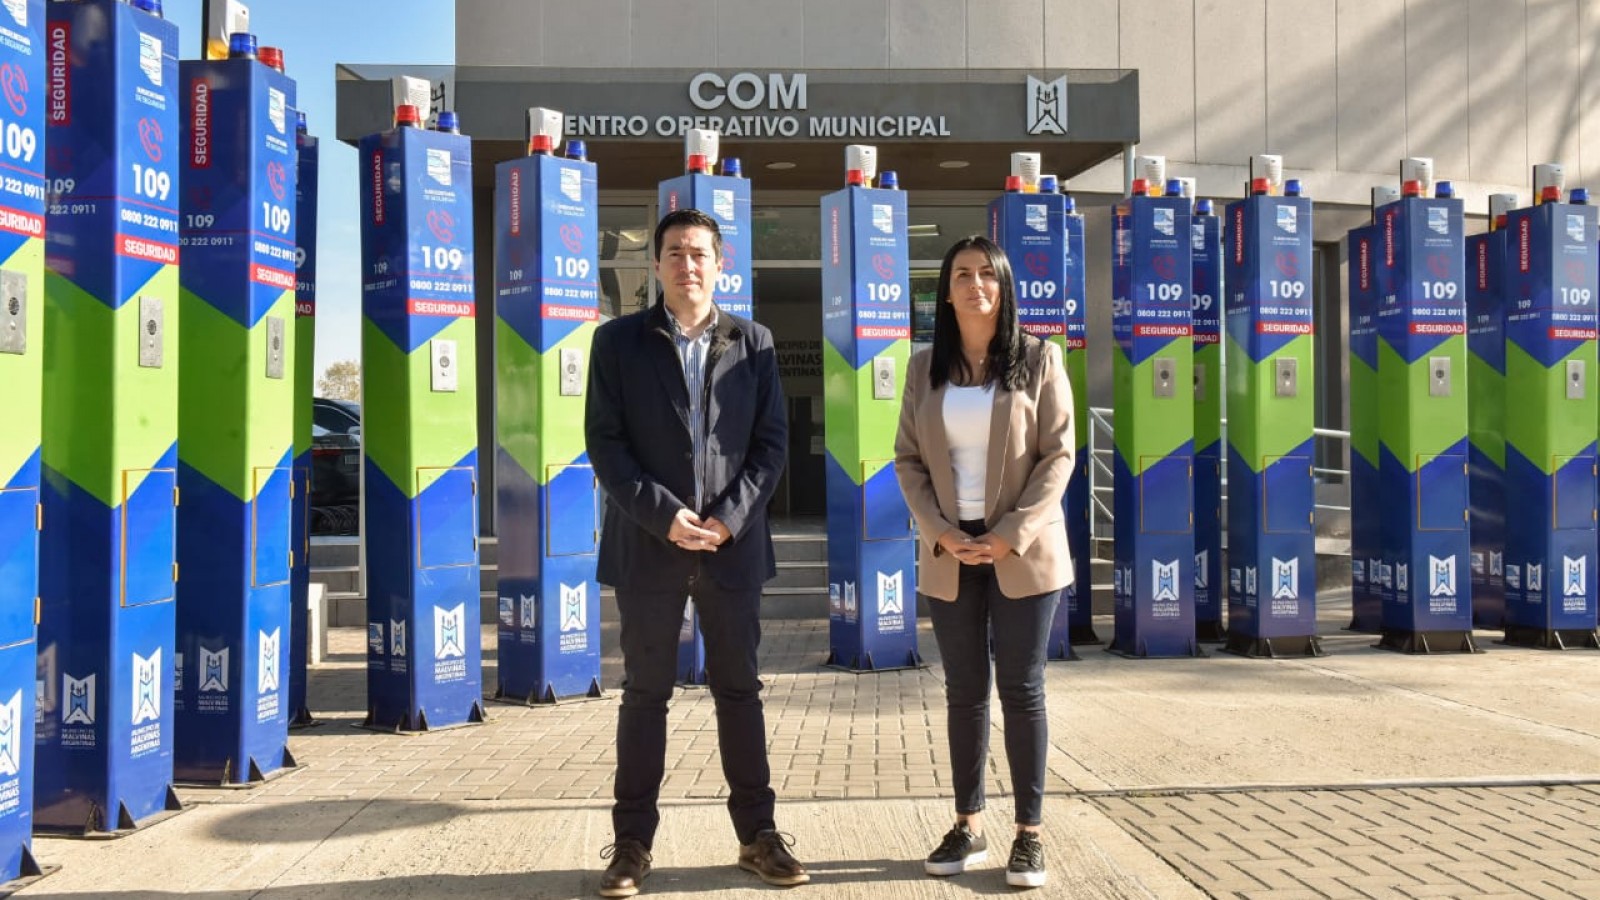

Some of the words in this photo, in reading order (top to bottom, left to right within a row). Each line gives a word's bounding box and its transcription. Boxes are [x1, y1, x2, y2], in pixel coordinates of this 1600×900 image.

[53, 28, 66, 120] SEGURIDAD
[689, 72, 808, 110] COM
[195, 83, 207, 164] SEGURIDAD
[564, 115, 649, 136] ENTRO
[655, 115, 799, 137] OPERATIVO
[809, 115, 951, 137] MUNICIPAL
[5, 177, 22, 194] 222
[24, 183, 45, 200] 0911
[132, 164, 170, 201] 109
[71, 204, 96, 214] 0911
[511, 172, 519, 233] SEGURIDAD
[0, 213, 41, 234] GURIDAD
[121, 209, 142, 226] 0800
[143, 214, 159, 229] 222
[159, 218, 178, 234] 0911
[187, 214, 215, 228] 109
[262, 201, 290, 234] 109
[124, 239, 176, 261] SEGURIDAD
[191, 238, 208, 246] 222
[210, 237, 233, 246] 0911
[421, 246, 462, 270] 109
[554, 256, 590, 279] 109
[256, 268, 293, 287] SEGURIDAD
[410, 280, 432, 291] 0800
[434, 283, 450, 292] 222
[452, 283, 473, 294] 0911
[544, 286, 563, 297] 0800
[564, 287, 579, 298] 222
[580, 288, 597, 300] 0911
[867, 283, 901, 302] 109
[1019, 280, 1056, 299] 109
[1146, 283, 1182, 301] 109
[1269, 280, 1305, 298] 109
[1422, 281, 1457, 299] 109
[1192, 294, 1212, 310] 09
[1560, 287, 1591, 305] 109
[414, 302, 470, 315] SEGURIDAD
[548, 307, 596, 319] SEGURIDAD
[858, 310, 876, 319] 0800
[878, 311, 891, 320] 222
[1018, 308, 1028, 316] 00
[1030, 308, 1044, 316] 222
[1046, 308, 1065, 316] 0911
[1137, 310, 1156, 318] 0800
[1158, 310, 1171, 318] 222
[1260, 307, 1278, 315] 0800
[1280, 307, 1293, 316] 222
[1412, 308, 1430, 316] 0800
[1432, 308, 1446, 316] 222
[862, 328, 907, 337] SEGURIDAD
[1023, 324, 1062, 333] GURIDAD
[1140, 326, 1188, 335] SEGURIDAD
[1263, 323, 1310, 333] SEGURIDAD
[1415, 323, 1463, 333] SEGURIDAD
[1554, 329, 1596, 338] SEGURIDAD
[777, 353, 822, 365] LVINAS
